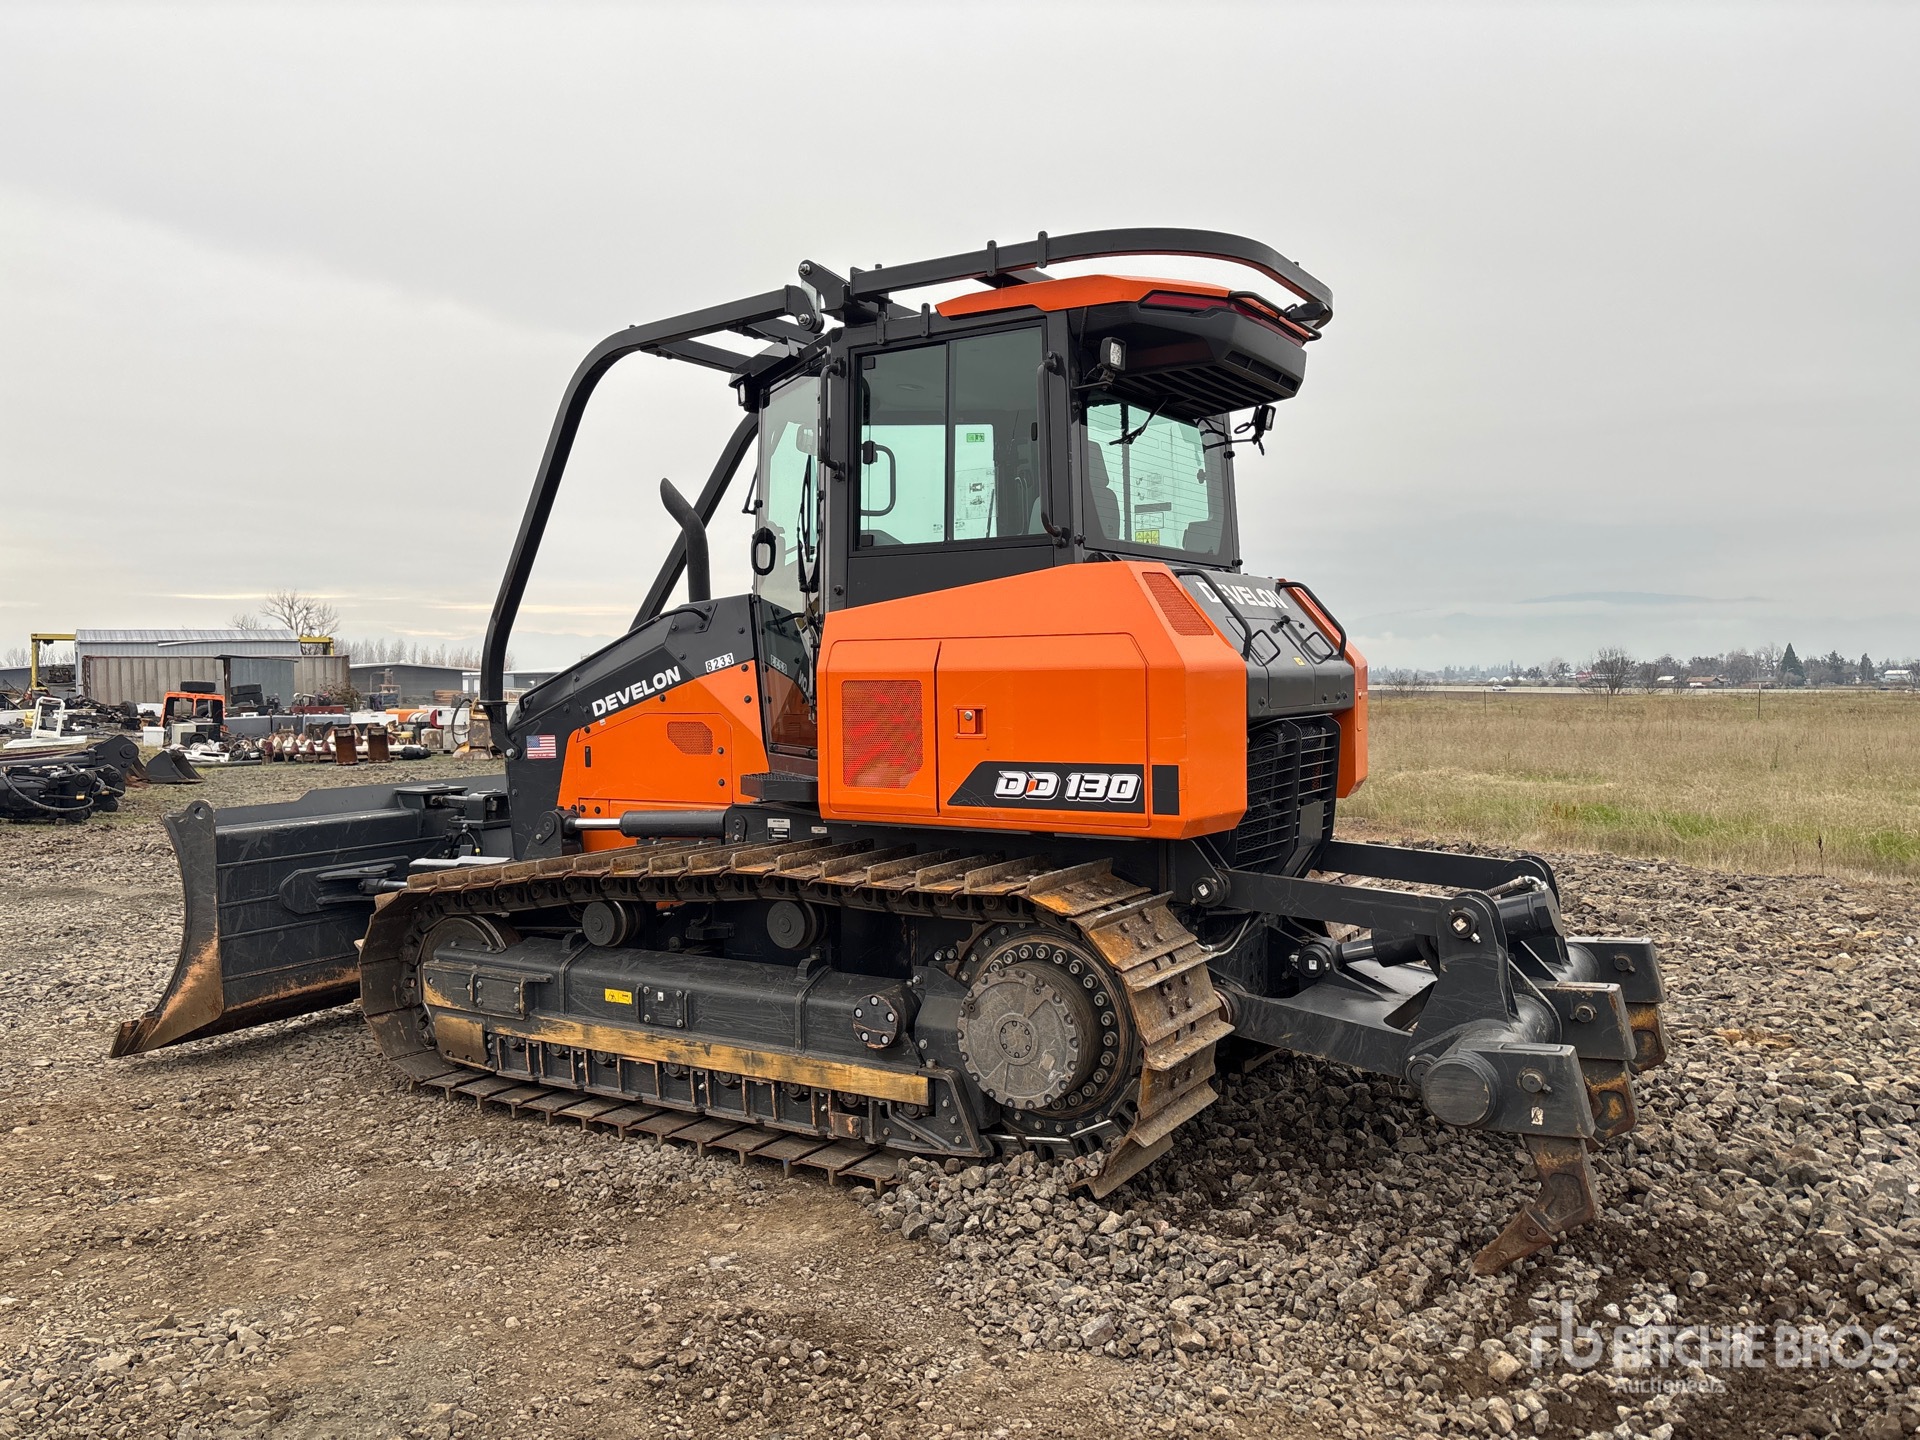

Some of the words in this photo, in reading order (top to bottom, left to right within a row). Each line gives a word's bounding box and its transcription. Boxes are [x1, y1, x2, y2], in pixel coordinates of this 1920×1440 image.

[706, 654, 733, 672] 8233
[591, 666, 681, 717] DEVELON
[994, 771, 1061, 800] DD
[1065, 773, 1142, 803] 130
